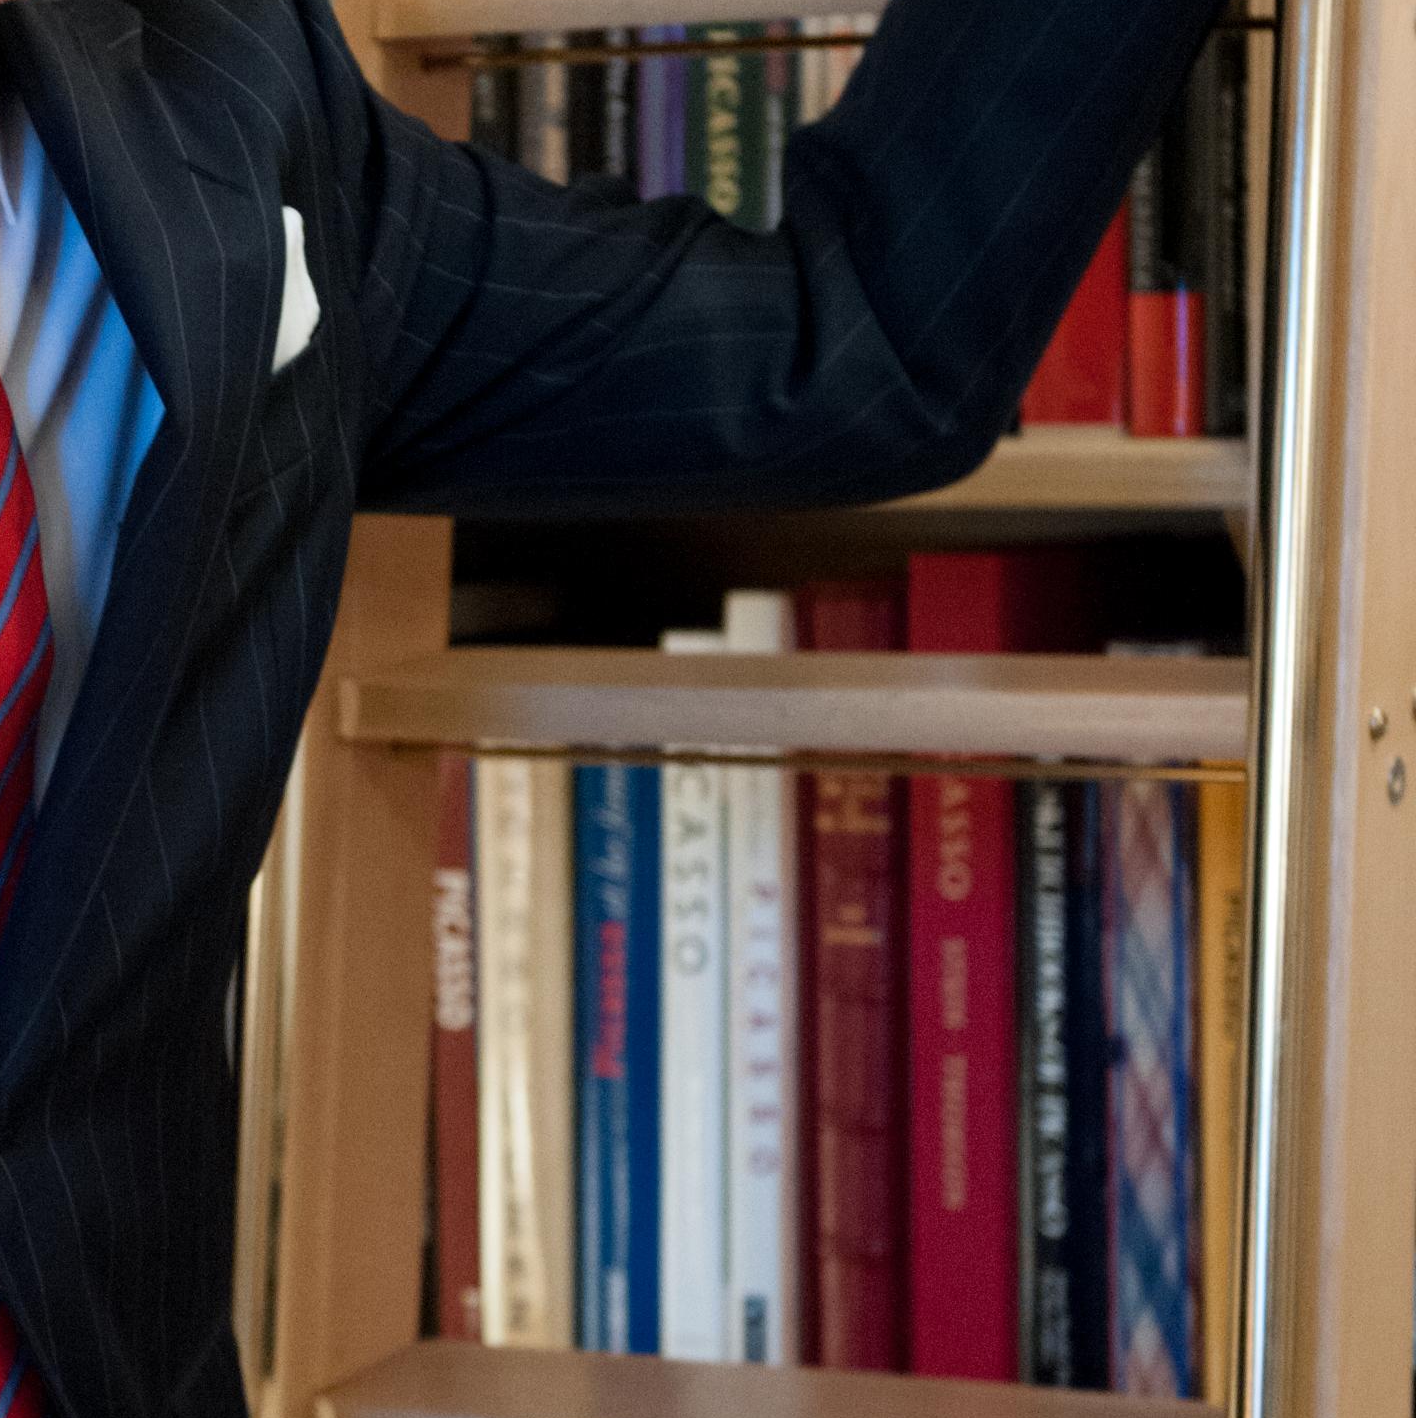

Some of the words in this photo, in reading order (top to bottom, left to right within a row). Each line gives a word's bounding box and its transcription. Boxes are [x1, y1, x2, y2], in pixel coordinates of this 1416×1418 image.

[433, 868, 474, 1031] PICASSO
[672, 766, 710, 977] CASSO
[749, 879, 781, 1179] PICASSO
